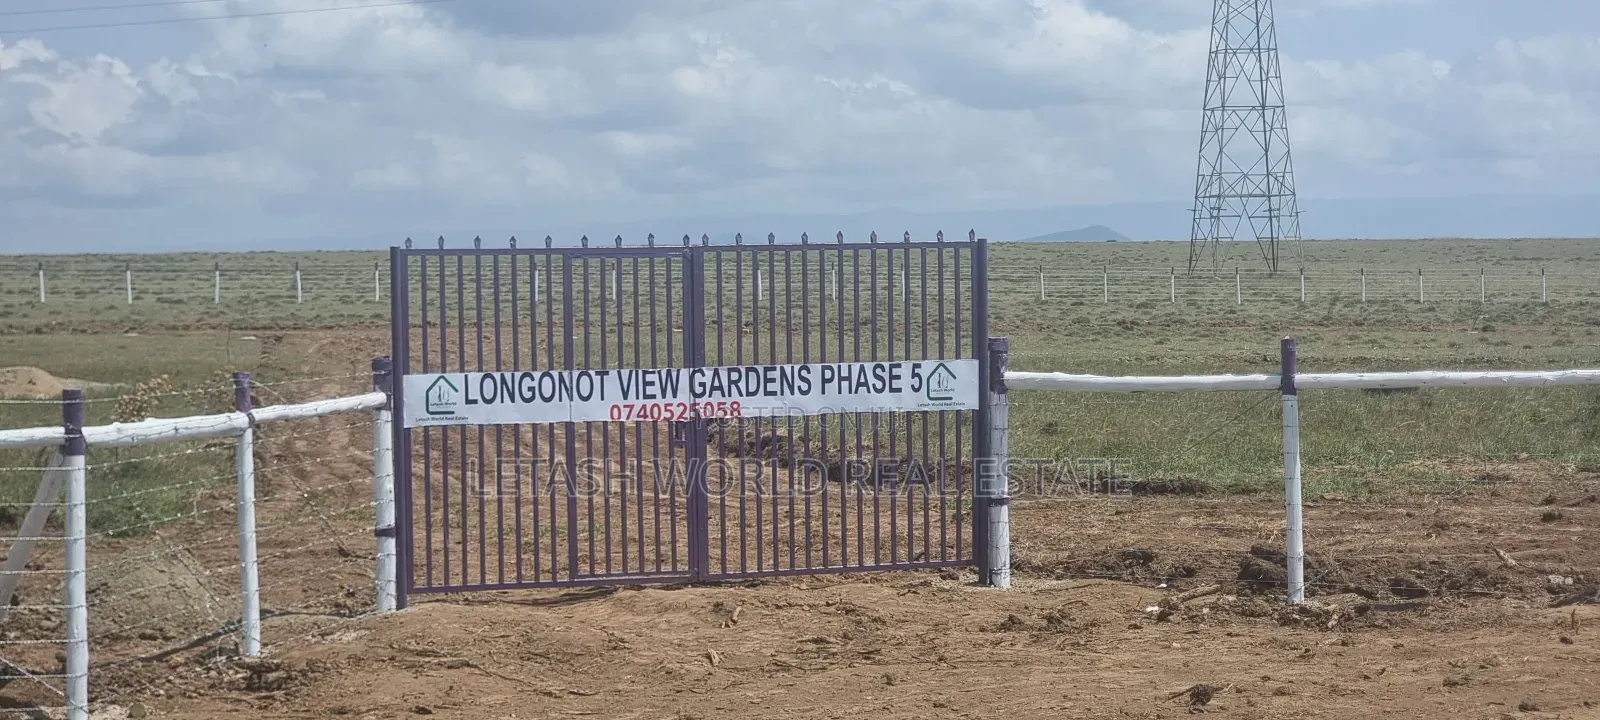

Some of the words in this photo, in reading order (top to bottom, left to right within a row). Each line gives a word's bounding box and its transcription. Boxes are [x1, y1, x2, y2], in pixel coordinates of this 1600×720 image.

[464, 370, 609, 405] LONGONOT
[617, 369, 681, 400] VIEW
[689, 364, 812, 399] GARDENS
[821, 363, 903, 395] PHASE
[910, 362, 923, 393] 5
[609, 401, 742, 421] 0740525058
